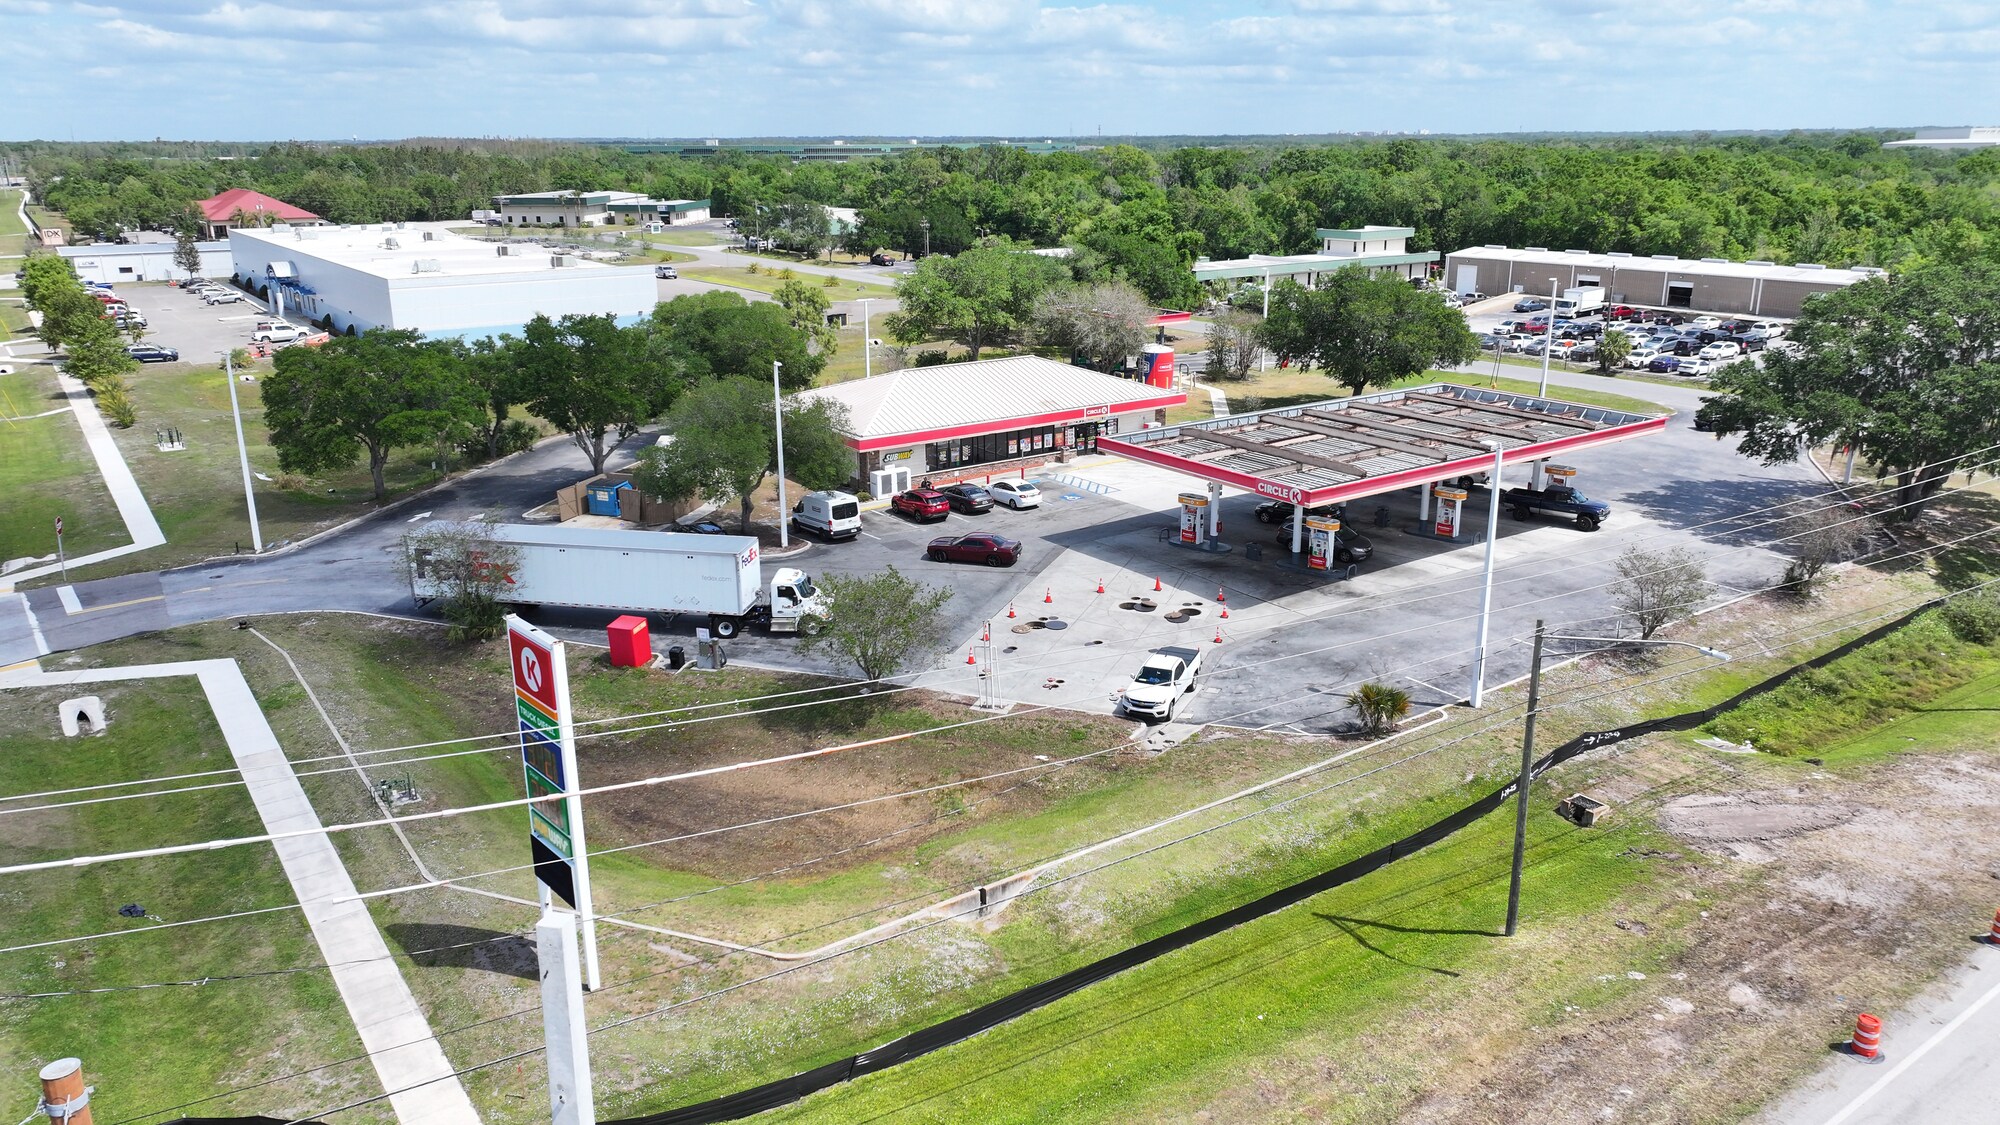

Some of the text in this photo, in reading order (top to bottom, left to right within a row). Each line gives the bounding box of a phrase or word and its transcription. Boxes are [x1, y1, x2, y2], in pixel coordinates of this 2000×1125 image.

[44, 230, 60, 238] IDX
[884, 450, 913, 462] SUBWAY
[1258, 483, 1302, 504] CIRCLE K
[741, 547, 758, 569] FedEx
[519, 705, 537, 724] TRUCK
[537, 717, 556, 737] DIESEL
[533, 816, 569, 852] SUBWAY
